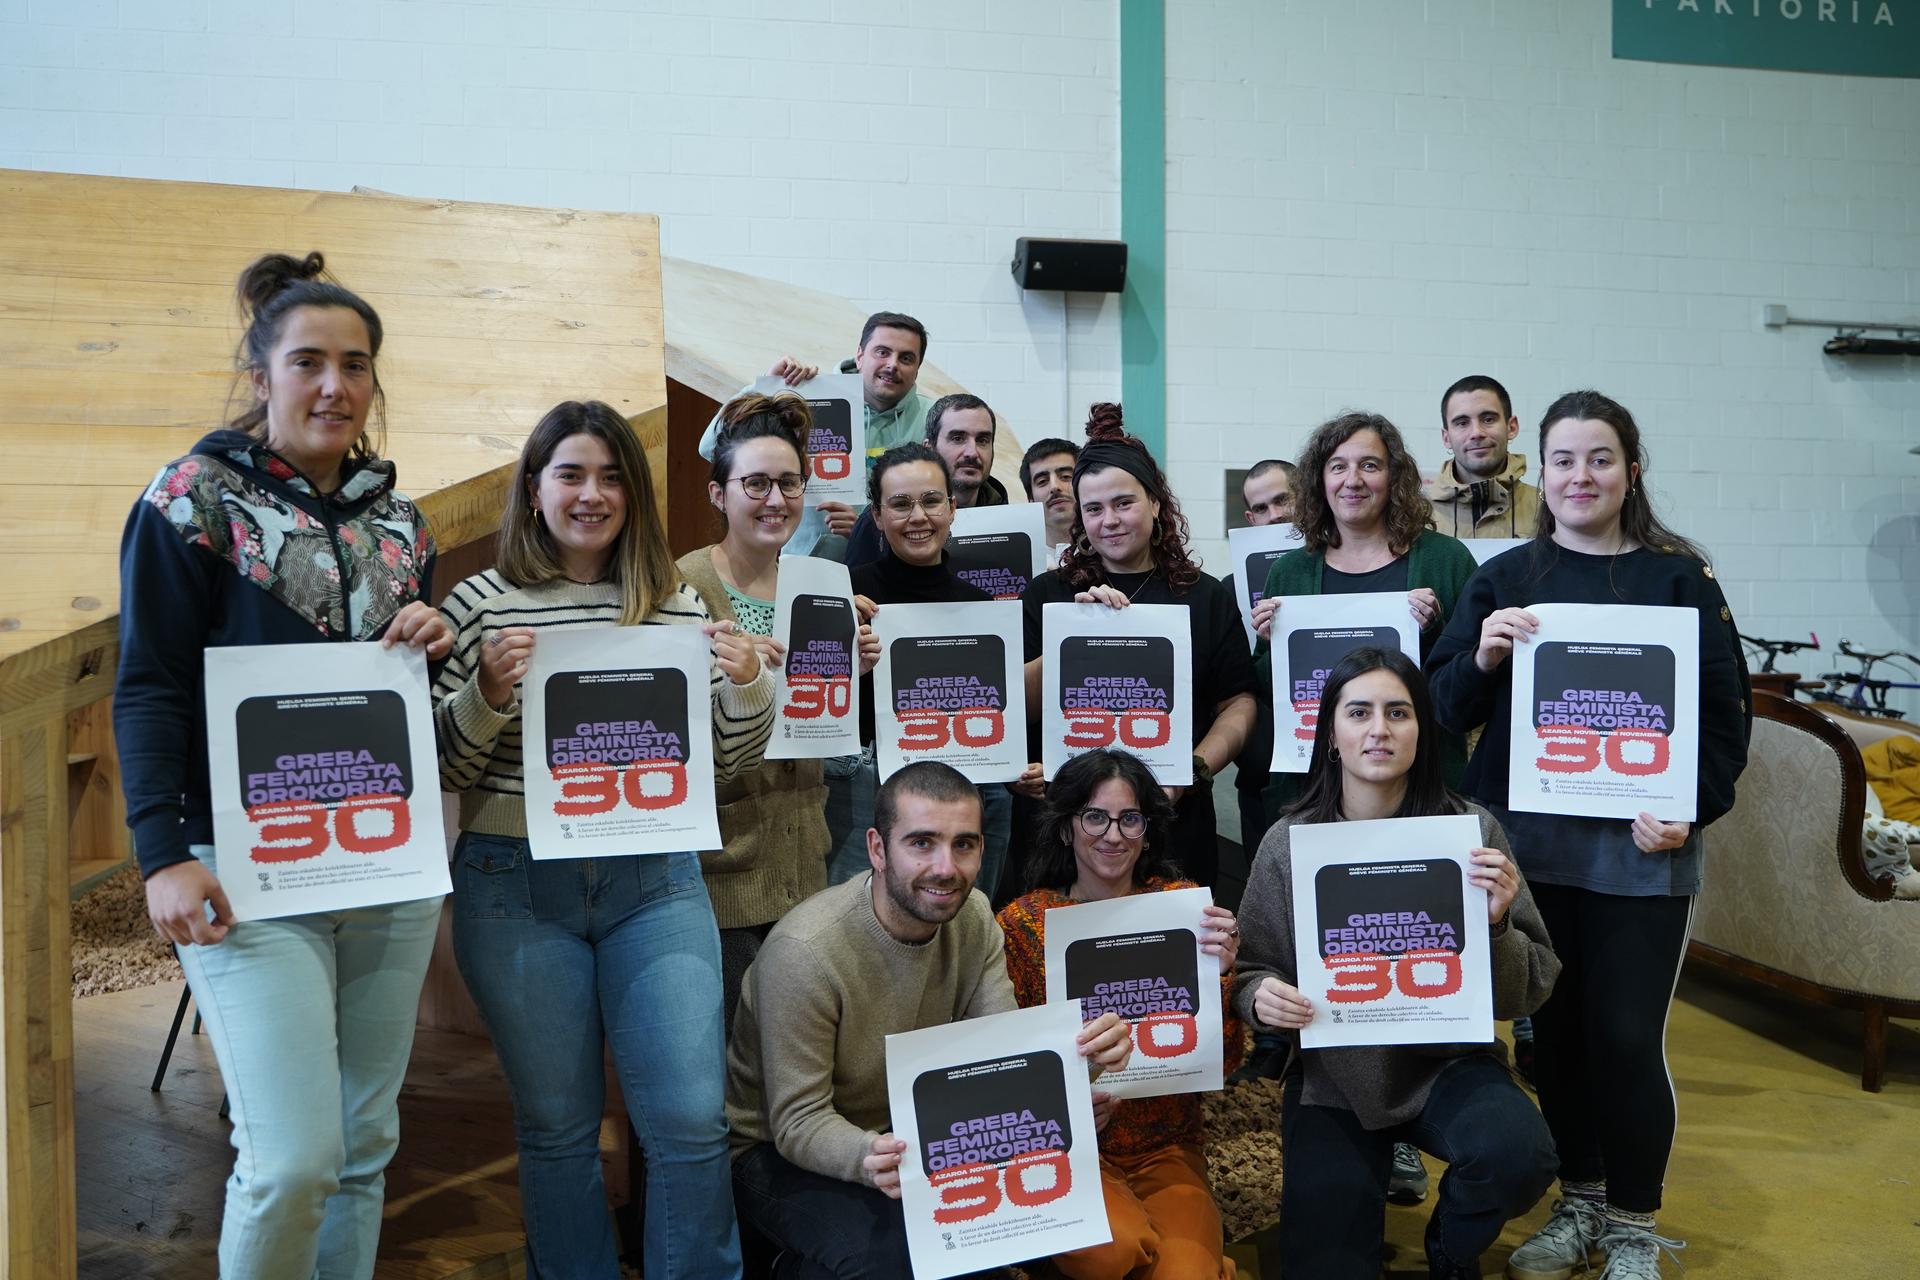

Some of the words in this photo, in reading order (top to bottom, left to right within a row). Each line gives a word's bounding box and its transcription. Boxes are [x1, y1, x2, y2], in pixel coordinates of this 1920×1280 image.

[808, 436, 847, 444] NISTA
[809, 428, 833, 436] EBA
[808, 444, 848, 452] ORRA
[957, 568, 1012, 580] GREBA
[970, 576, 1027, 588] INISTA
[981, 585, 1026, 596] ORRA
[808, 640, 843, 652] GREBA
[792, 652, 850, 664] FEMINISTA
[790, 663, 850, 674] OROKORRA
[915, 676, 981, 688] GREBA
[1083, 677, 1149, 688] GREBA
[783, 674, 851, 719] 30
[898, 686, 999, 699] FEMINISTA
[1065, 687, 1167, 698] FEMINISTA
[1562, 689, 1644, 704] GREBA
[897, 697, 1000, 710] OROKORRA
[1064, 698, 1167, 709] OROKORRA
[1539, 700, 1666, 717] FEMINISTA
[575, 720, 658, 736] GREBA
[896, 707, 1004, 751] 30
[1064, 708, 1170, 749] 30
[1538, 713, 1666, 730] OROKORRA
[553, 732, 680, 751] FEMINISTA
[1537, 726, 1669, 775] 30
[276, 749, 375, 770] GREBA
[552, 745, 682, 765] OROKORRA
[248, 763, 401, 788] FEMINISTA
[248, 778, 404, 805] OROKORRA
[551, 758, 688, 816] 30
[254, 806, 292, 815] AZAROA
[295, 801, 349, 811] NOVIEMBRE
[351, 796, 401, 806] NOVEMBRE
[247, 793, 411, 863] 30
[1348, 910, 1432, 927] GREBA
[1325, 922, 1455, 941] FEMINISTA
[1325, 936, 1456, 955] OROKORRA
[1324, 949, 1462, 1003] 30
[1094, 976, 1169, 995] GREBA
[1150, 1013, 1189, 1021] NOVEMBRE
[950, 1108, 1036, 1137] GREBA
[928, 1118, 1061, 1156] FEMINISTA
[928, 1132, 1064, 1172] OROKORRA
[934, 1169, 968, 1180] AZAROA
[970, 1159, 1017, 1173] NOVIEMBRE
[1018, 1150, 1062, 1164] NOVEMBRE
[928, 1149, 1072, 1224] 30
